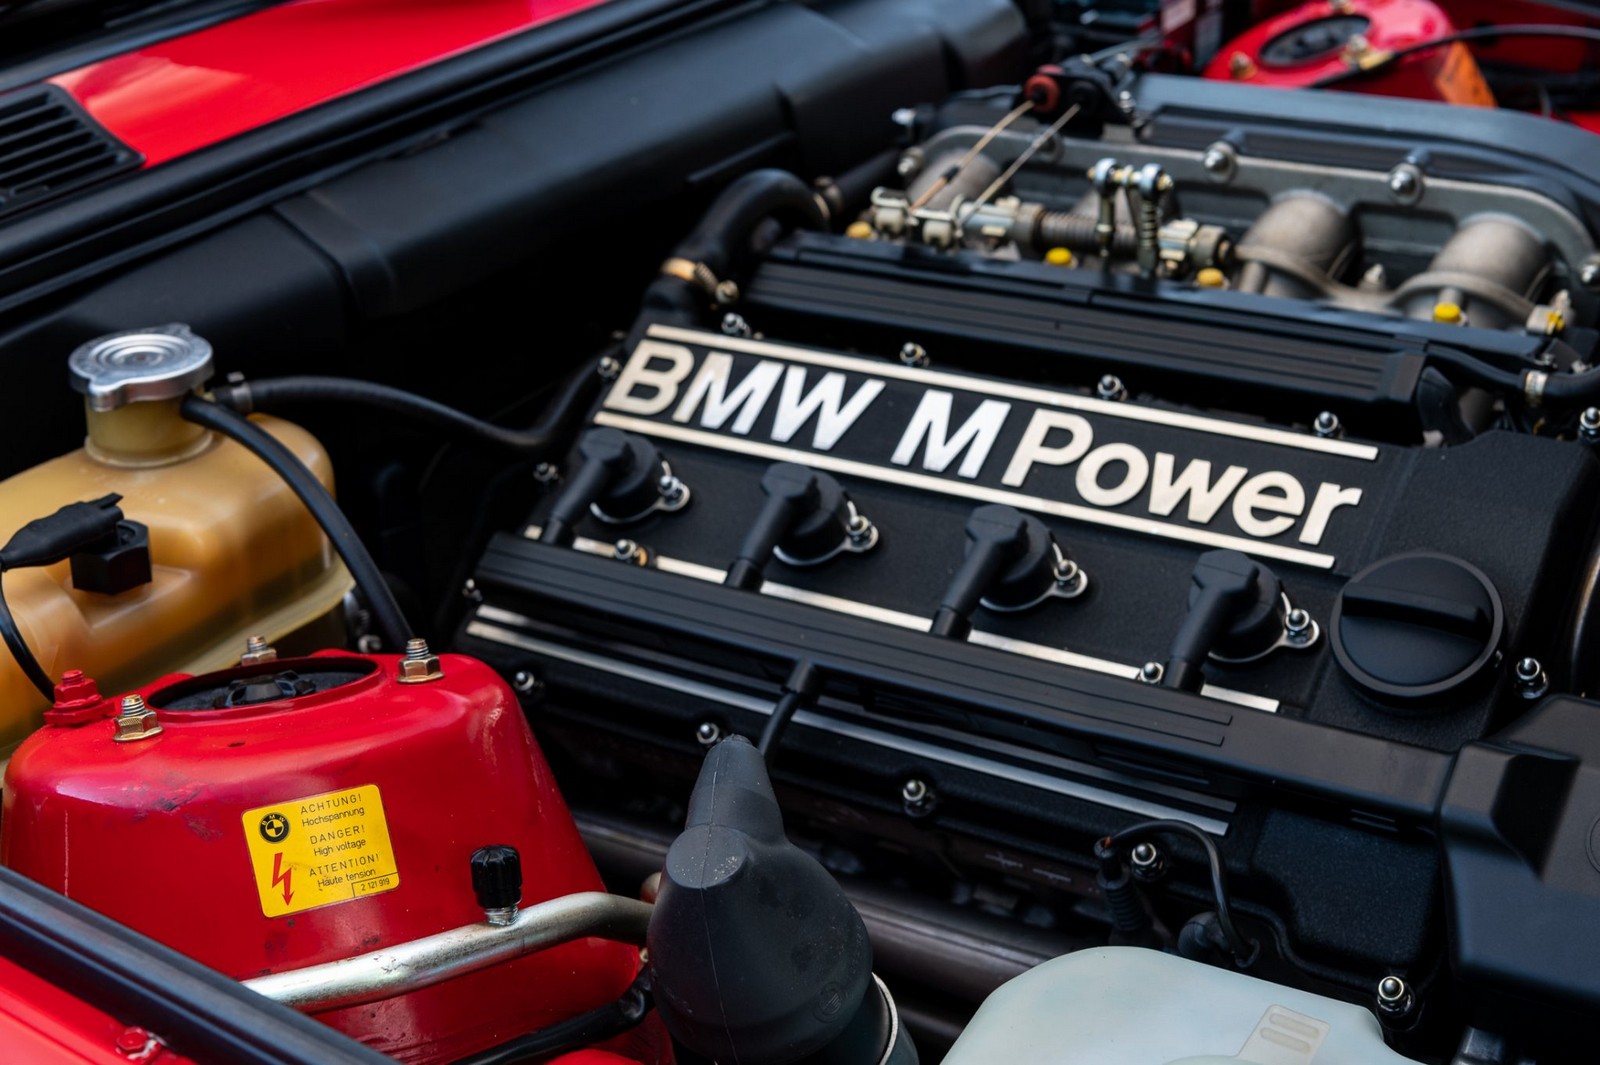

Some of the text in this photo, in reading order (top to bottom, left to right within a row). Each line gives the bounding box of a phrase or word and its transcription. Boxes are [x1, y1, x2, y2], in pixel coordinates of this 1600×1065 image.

[603, 339, 886, 451] BMW
[300, 793, 362, 815] ACHTUNG!
[262, 814, 285, 826] BMW
[302, 806, 365, 827] Hochspannung
[310, 825, 365, 845] DANGER!
[313, 838, 367, 857] High voltage
[309, 854, 379, 877] ATTENTION!
[317, 868, 376, 888] Haute tension
[368, 881, 377, 889] 121
[379, 878, 390, 887] 919
